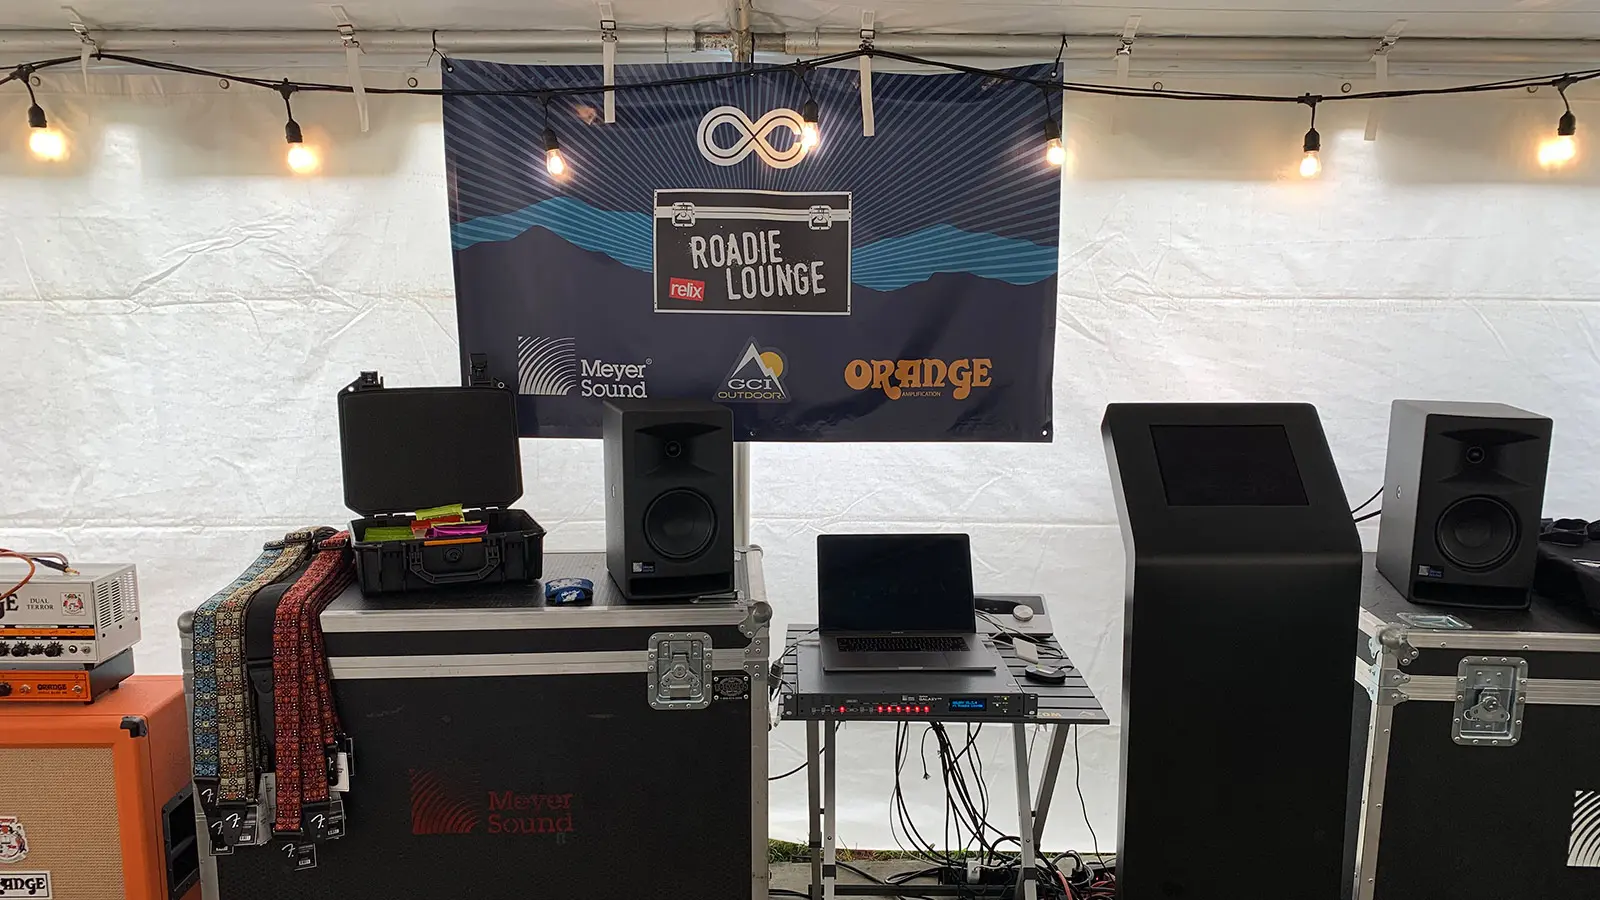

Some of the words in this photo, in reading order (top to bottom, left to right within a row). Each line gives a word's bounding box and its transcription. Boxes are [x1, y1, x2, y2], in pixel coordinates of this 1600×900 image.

[690, 230, 783, 269] ROADIE
[671, 281, 703, 299] relix
[726, 261, 826, 300] LOUNGE
[581, 379, 648, 398] Sound
[727, 379, 772, 390] GCI
[844, 358, 993, 400] ORANGE
[717, 391, 783, 400] OUTDOOR
[488, 791, 573, 812] Meyer
[488, 813, 575, 834] Sound
[0, 877, 46, 895] ANGE
